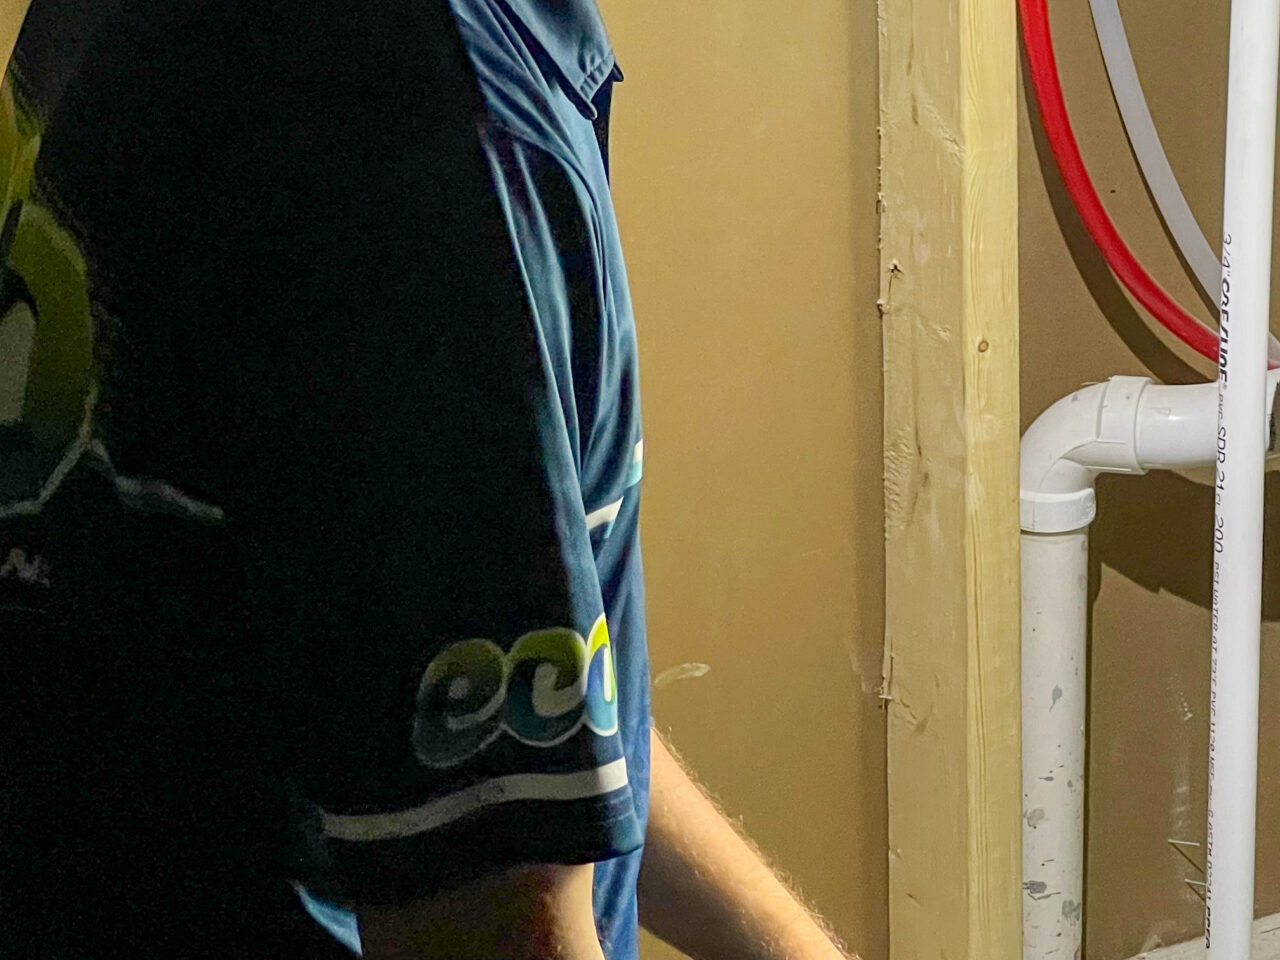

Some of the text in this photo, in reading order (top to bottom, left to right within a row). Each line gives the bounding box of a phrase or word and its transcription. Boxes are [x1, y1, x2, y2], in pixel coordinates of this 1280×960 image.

[1216, 427, 1226, 463] SDR
[1216, 471, 1225, 491] 21
[1213, 516, 1224, 553] 200
